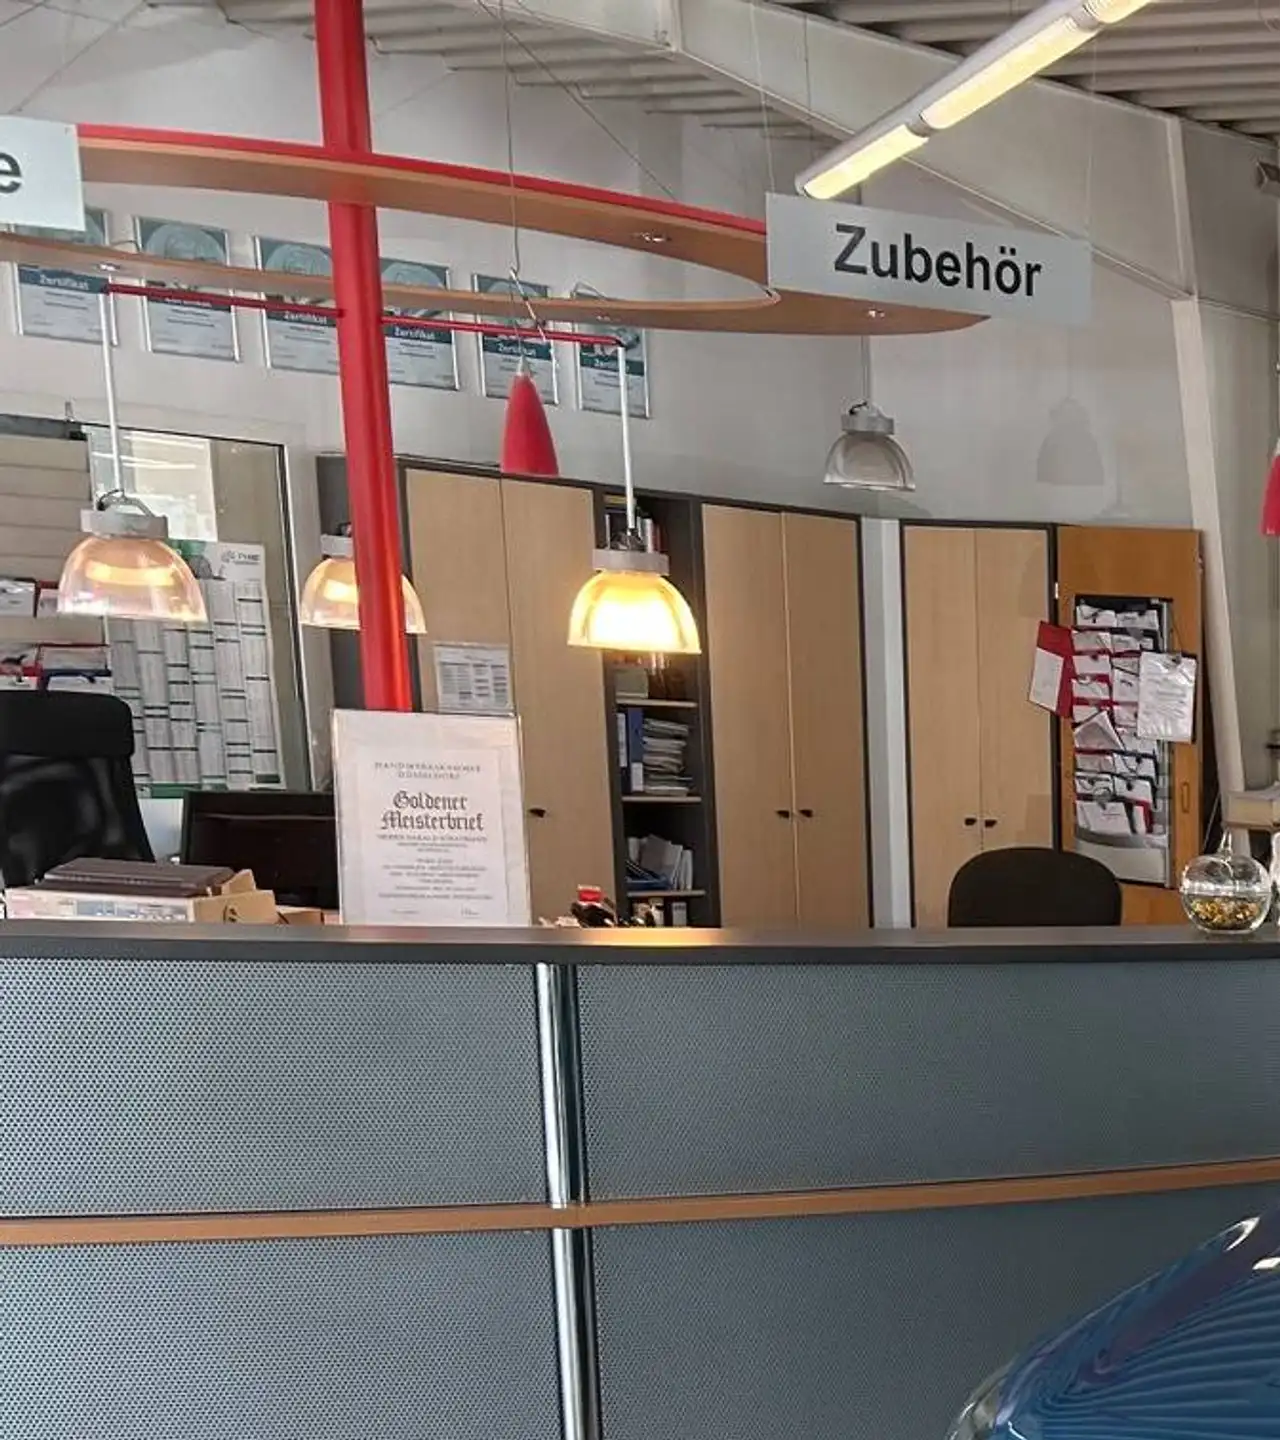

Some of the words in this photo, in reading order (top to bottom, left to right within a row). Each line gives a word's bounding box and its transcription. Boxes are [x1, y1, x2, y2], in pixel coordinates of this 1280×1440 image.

[834, 222, 1042, 297] Zubehör
[393, 789, 468, 811] Goldener
[380, 810, 485, 832] Meisterbrief
